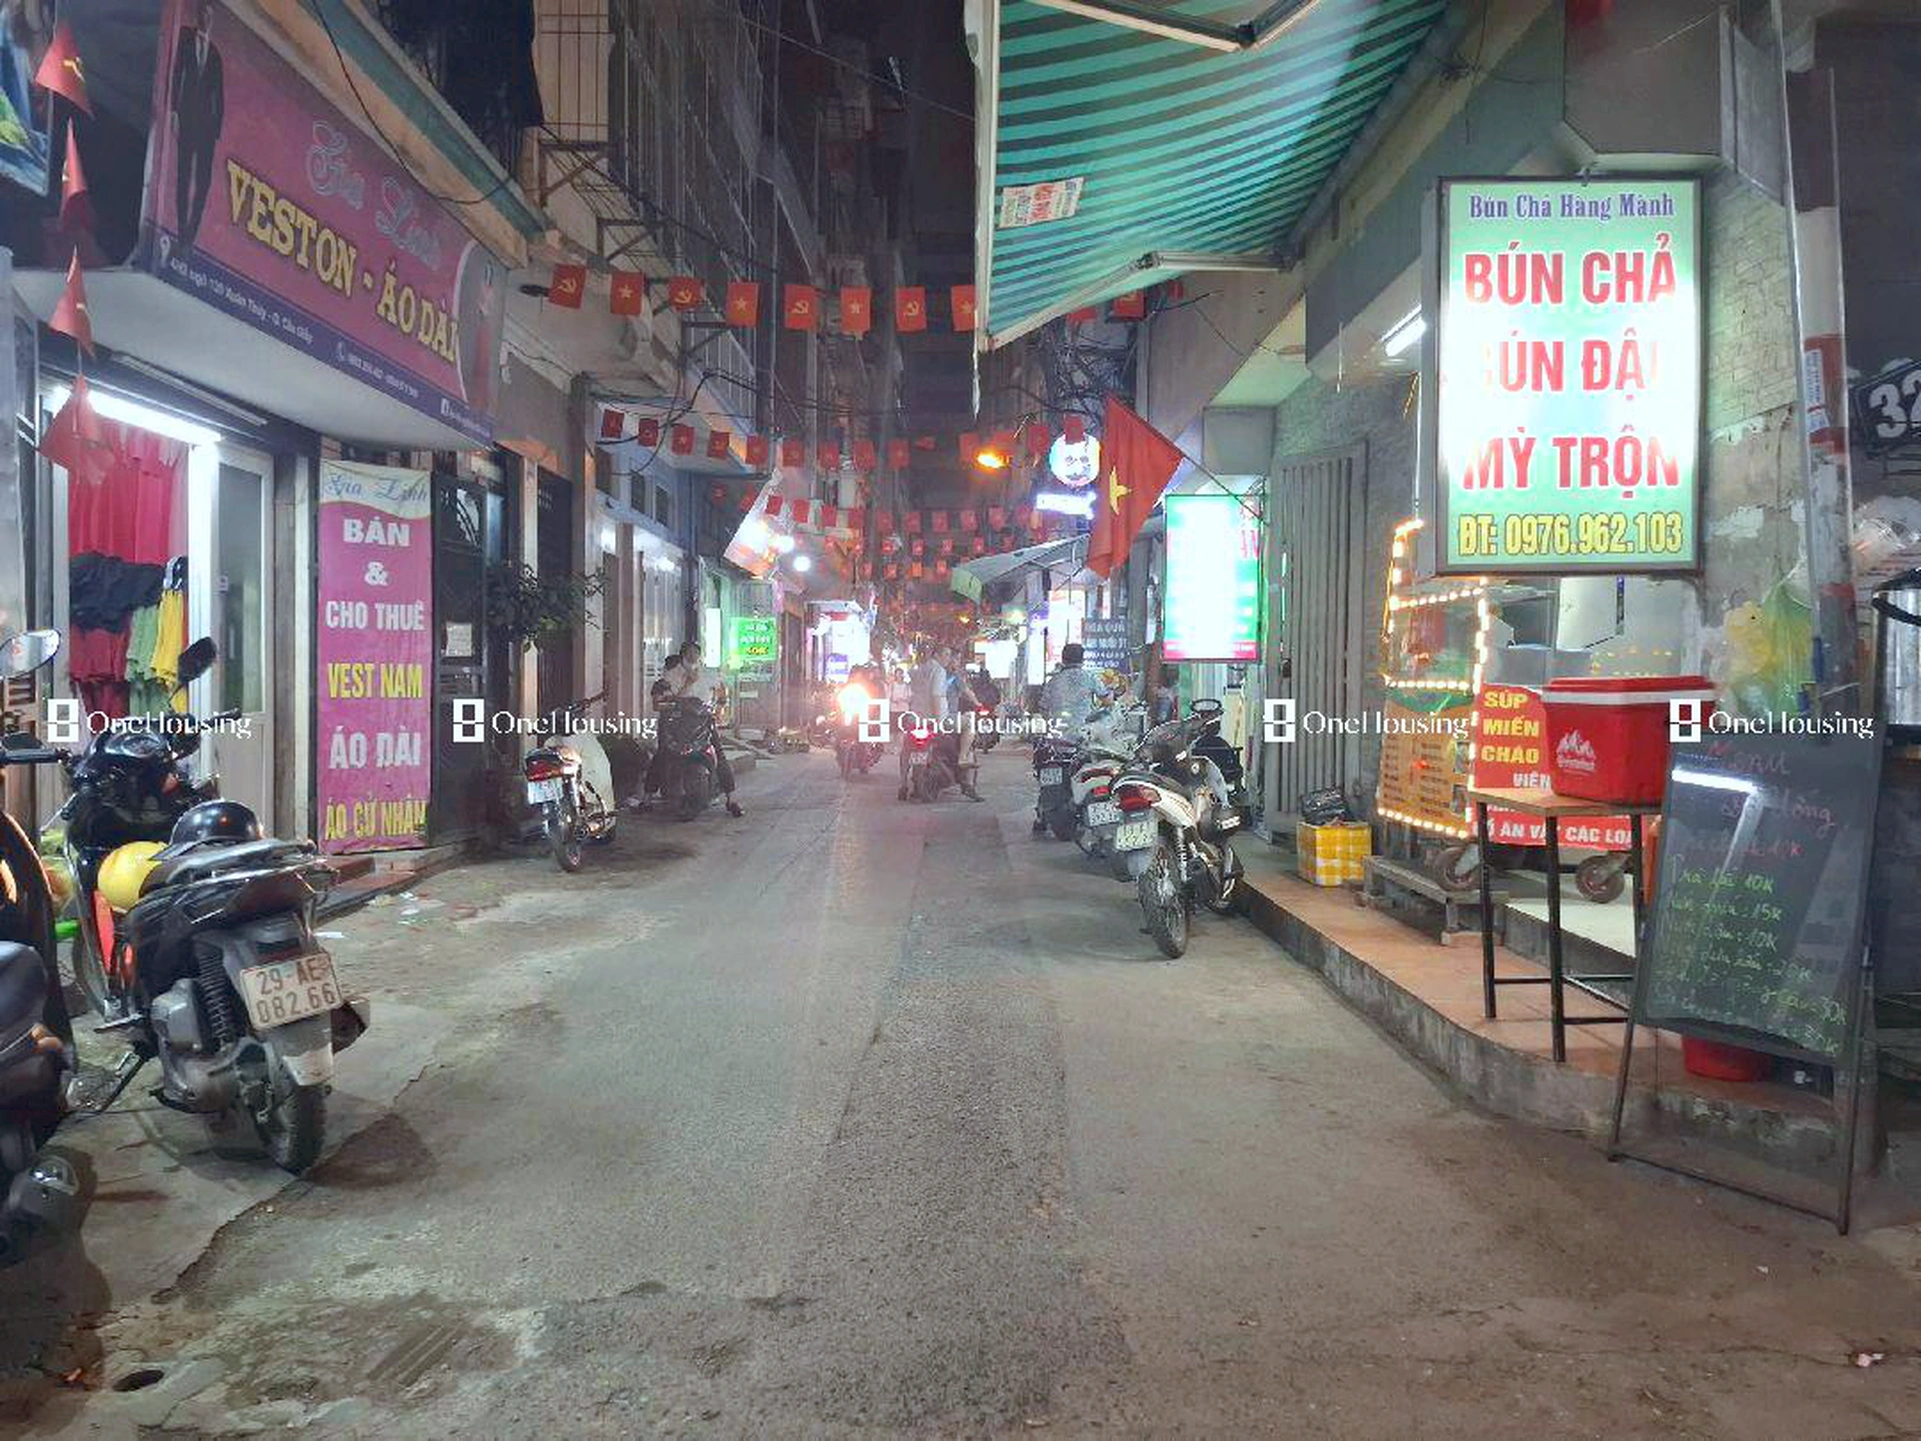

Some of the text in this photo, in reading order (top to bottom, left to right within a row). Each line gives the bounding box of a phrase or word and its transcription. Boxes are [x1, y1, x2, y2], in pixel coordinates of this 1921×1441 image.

[1470, 195, 1508, 218] Bún
[227, 159, 357, 298] VESTON
[376, 256, 416, 334] ÁO
[1465, 232, 1676, 305] BÚN CHẢ
[1552, 424, 1679, 499] TRỘN
[343, 516, 410, 547] BÁN
[1458, 511, 1683, 556] ĐT: 0976.962.103
[364, 561, 389, 587] &
[325, 599, 425, 632] CHO THUÊ
[328, 663, 423, 698] VEST NAM
[1483, 715, 1540, 737] MIẾN
[329, 725, 422, 770] ÁO DÀI
[325, 797, 348, 841] ÁO
[256, 982, 335, 1023] 082.66
